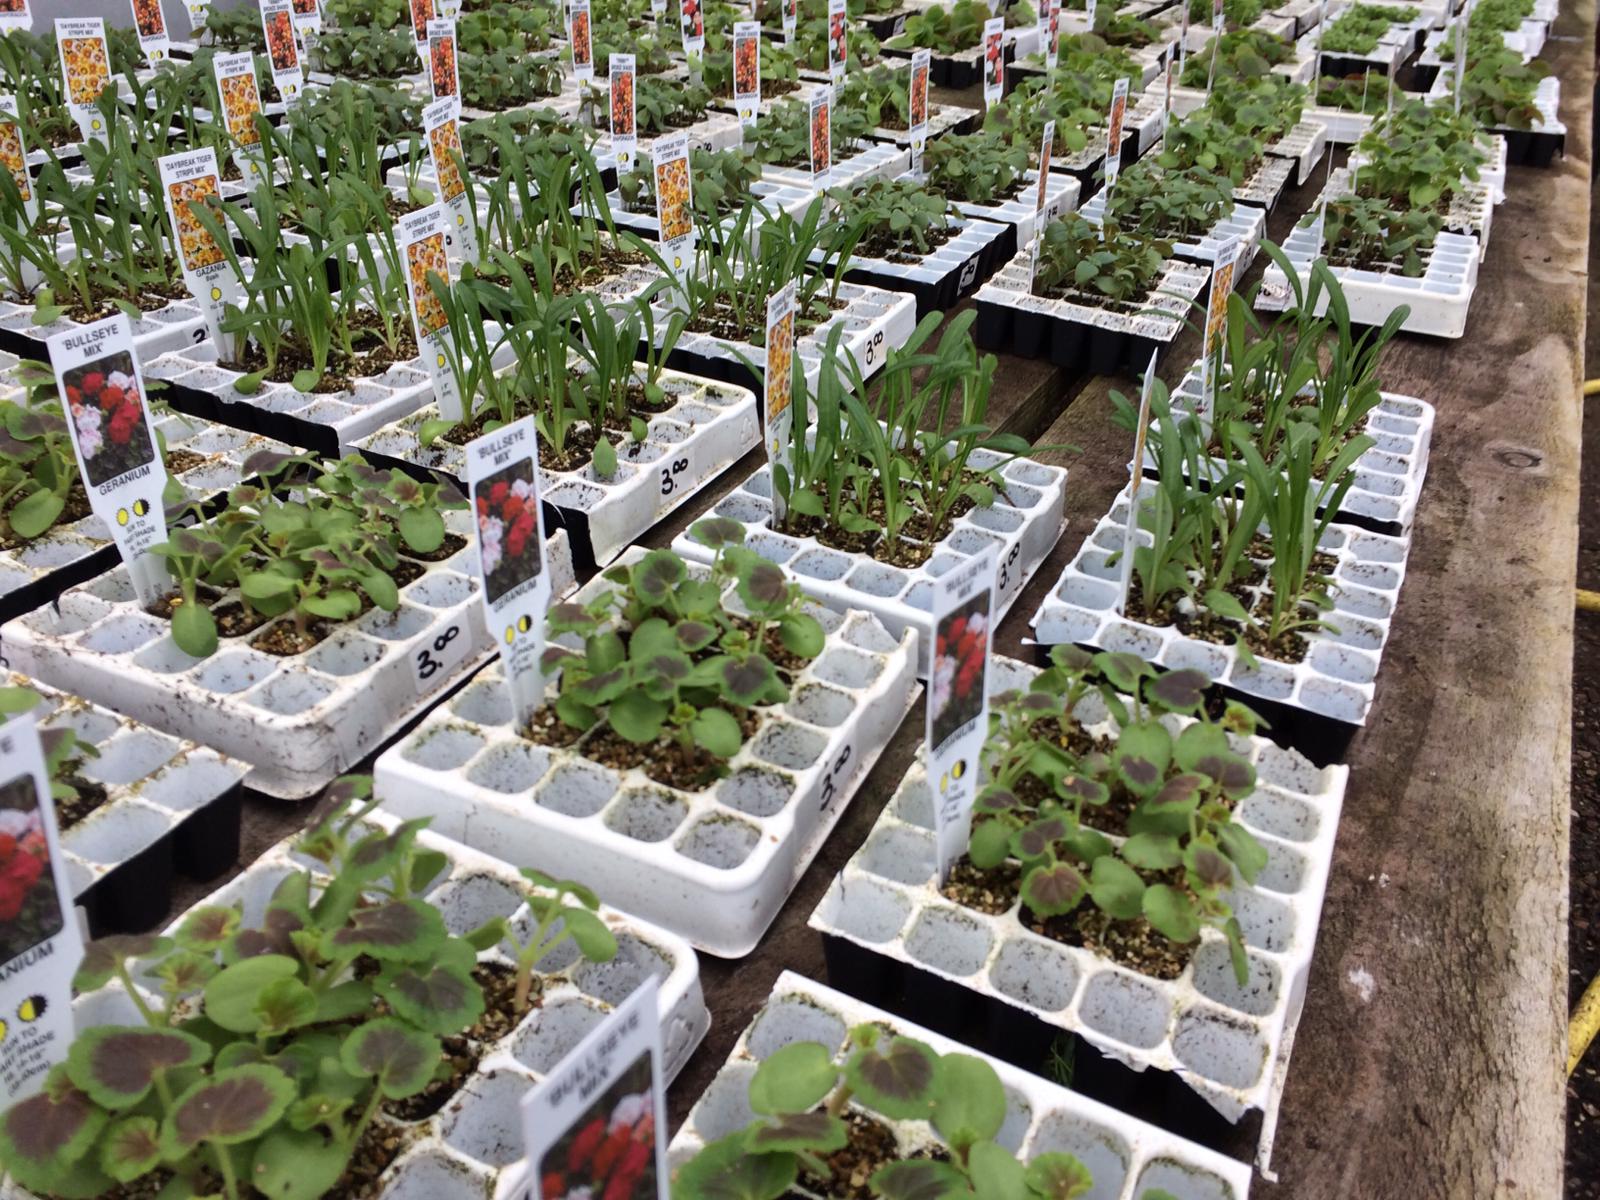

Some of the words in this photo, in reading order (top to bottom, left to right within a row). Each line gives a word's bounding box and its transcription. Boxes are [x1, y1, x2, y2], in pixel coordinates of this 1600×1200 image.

[175, 168, 195, 179] STRIPE
[196, 154, 212, 164] TIGER
[195, 262, 227, 278] GAZANIA
[865, 330, 884, 365] 3.00
[99, 465, 151, 496] GERANIUM
[661, 457, 689, 496] 3.00
[999, 541, 1020, 590] 3.00
[493, 578, 537, 613] GERANIUM
[417, 625, 460, 679] 3.00
[819, 744, 852, 812] 3.00
[21, 1025, 38, 1039] TO
